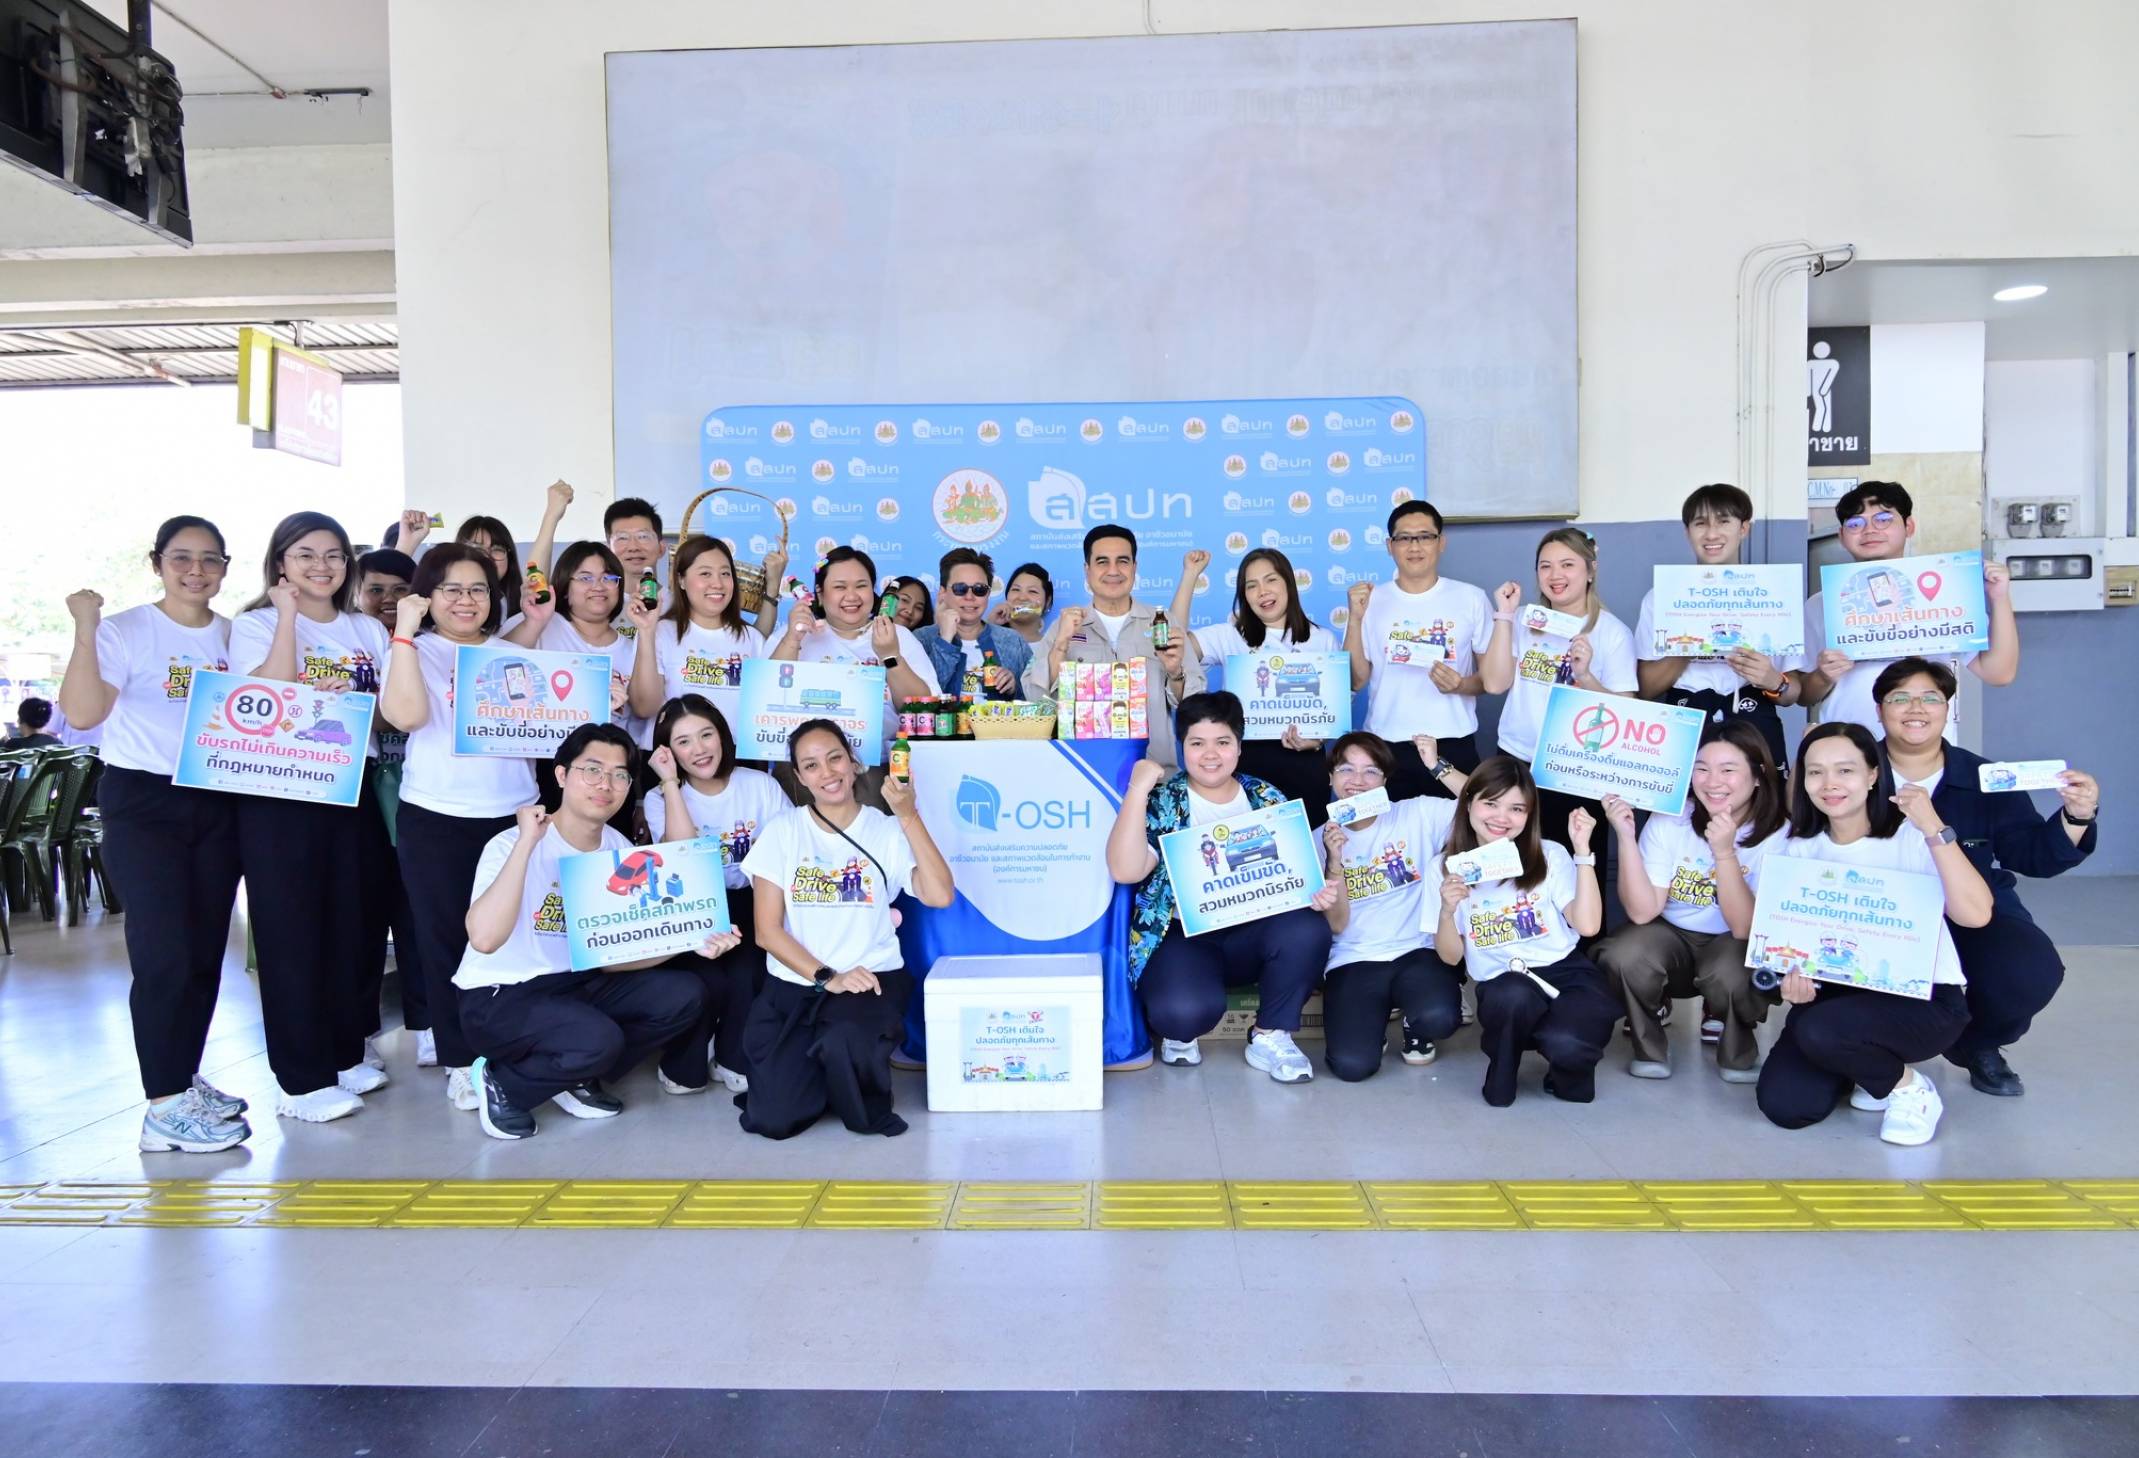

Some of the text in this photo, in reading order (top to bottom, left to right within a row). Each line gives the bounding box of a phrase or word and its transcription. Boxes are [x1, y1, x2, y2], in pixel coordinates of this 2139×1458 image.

[307, 389, 339, 432] 43
[1046, 488, 1192, 520] สสปท
[1688, 588, 1728, 597] T-OSH
[1836, 621, 1975, 645] และขับขี่อย่างมีสติ
[304, 656, 333, 667] Safe
[687, 663, 724, 677] Drive
[237, 695, 273, 717] 80
[476, 703, 590, 722] ศึกษาเส้นทาง
[1624, 719, 1666, 745] NO
[196, 733, 353, 766] ขับรถไม่เกินความเร็ว
[1621, 743, 1661, 756] ALCOHOL
[959, 801, 1090, 831] T-OSH
[796, 866, 824, 878] Safe
[1345, 872, 1385, 890] Drive
[794, 877, 837, 893] Drive
[1199, 876, 1305, 914] สวมหมวกนิรภัย
[1671, 877, 1715, 898] Drive
[1800, 887, 1849, 905] T-OSH
[577, 896, 718, 930] ตรวจเช็คสภาพรถ
[1780, 900, 1914, 929] ปลอดภัยทุกเส้นทาง
[587, 917, 714, 949] ก่อนออกเดินทาง
[1473, 921, 1513, 938] Drive
[986, 1026, 1016, 1034] T-OSH
